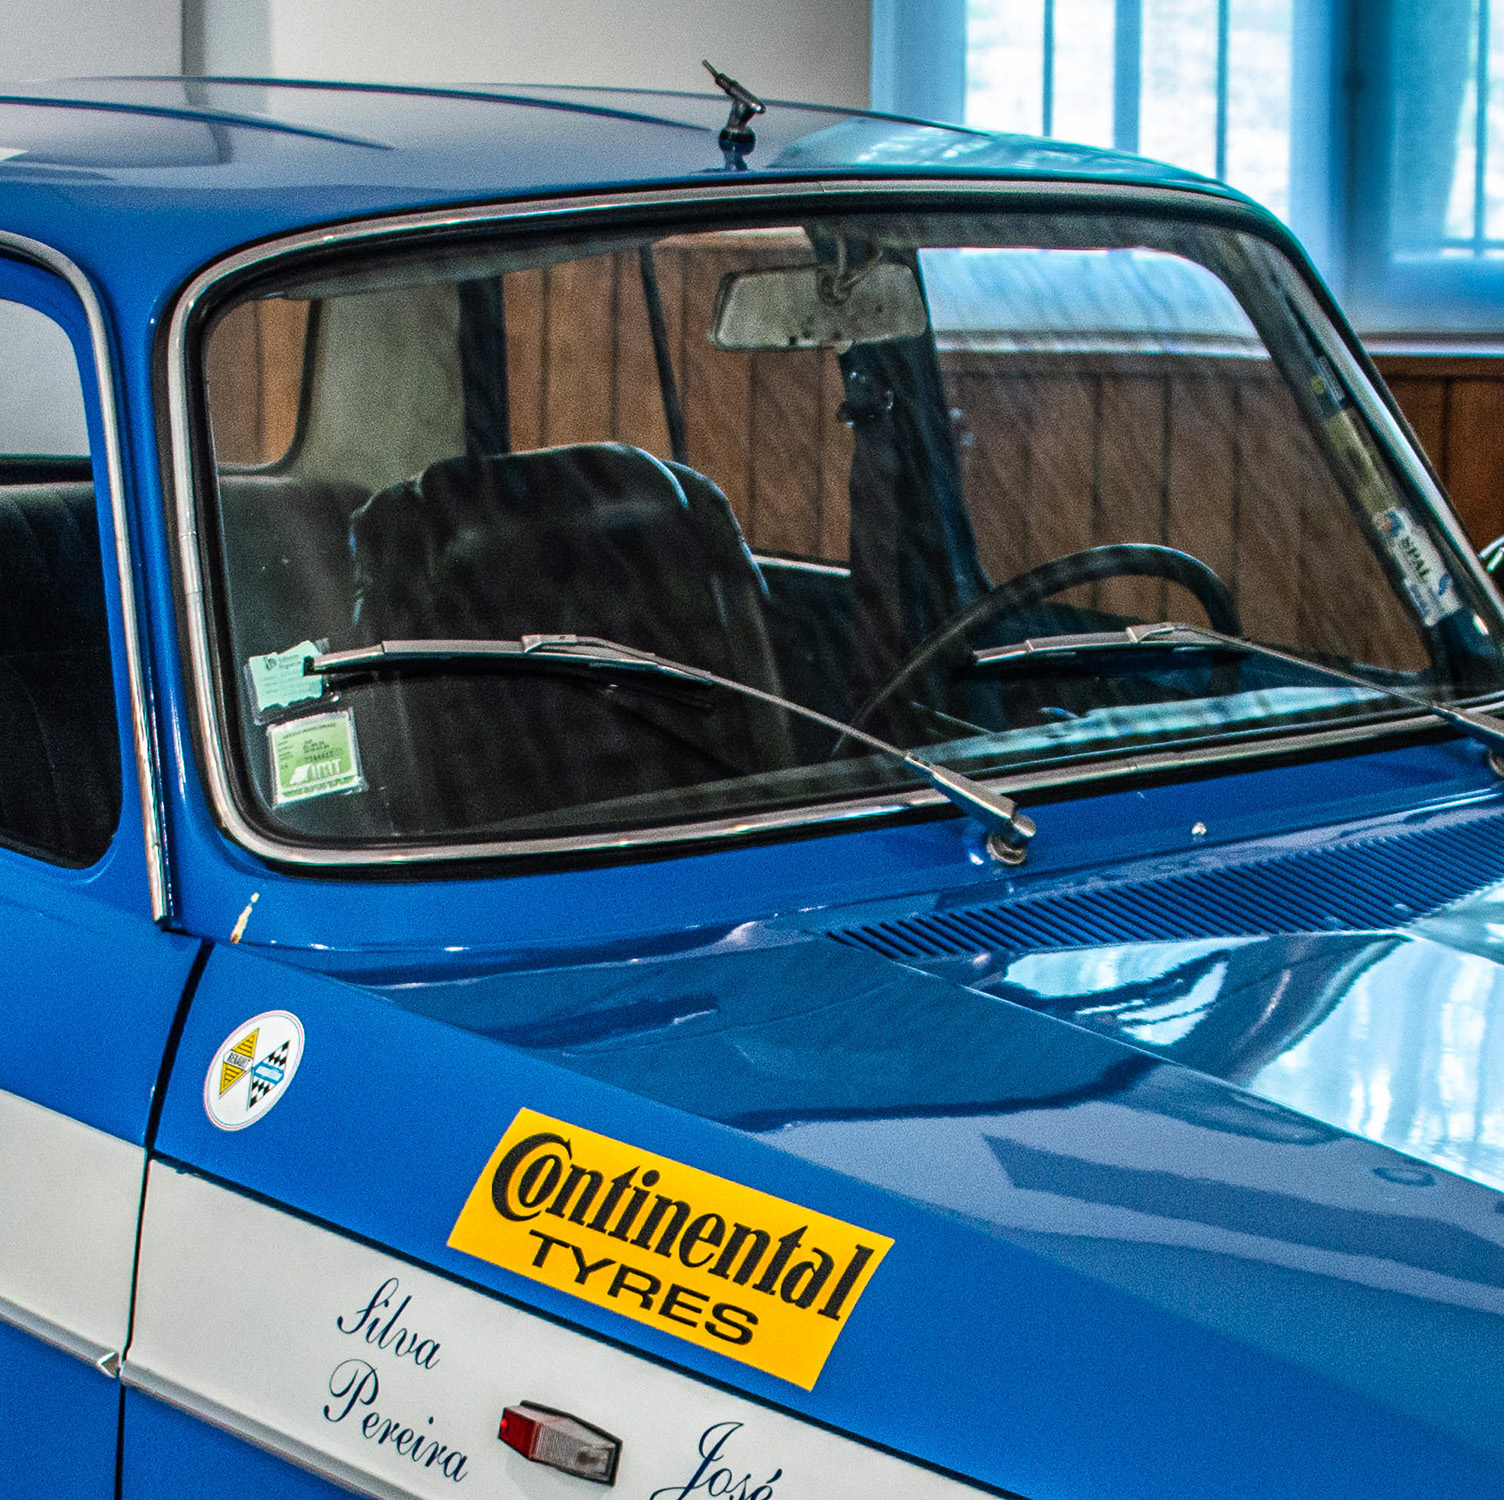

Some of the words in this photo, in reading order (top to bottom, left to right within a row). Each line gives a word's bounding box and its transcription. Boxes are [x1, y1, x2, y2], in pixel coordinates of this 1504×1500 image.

[491, 1131, 874, 1323] Continental
[529, 1229, 760, 1347] TYRES
[337, 1277, 442, 1370] Silva
[322, 1358, 469, 1484] Pereira
